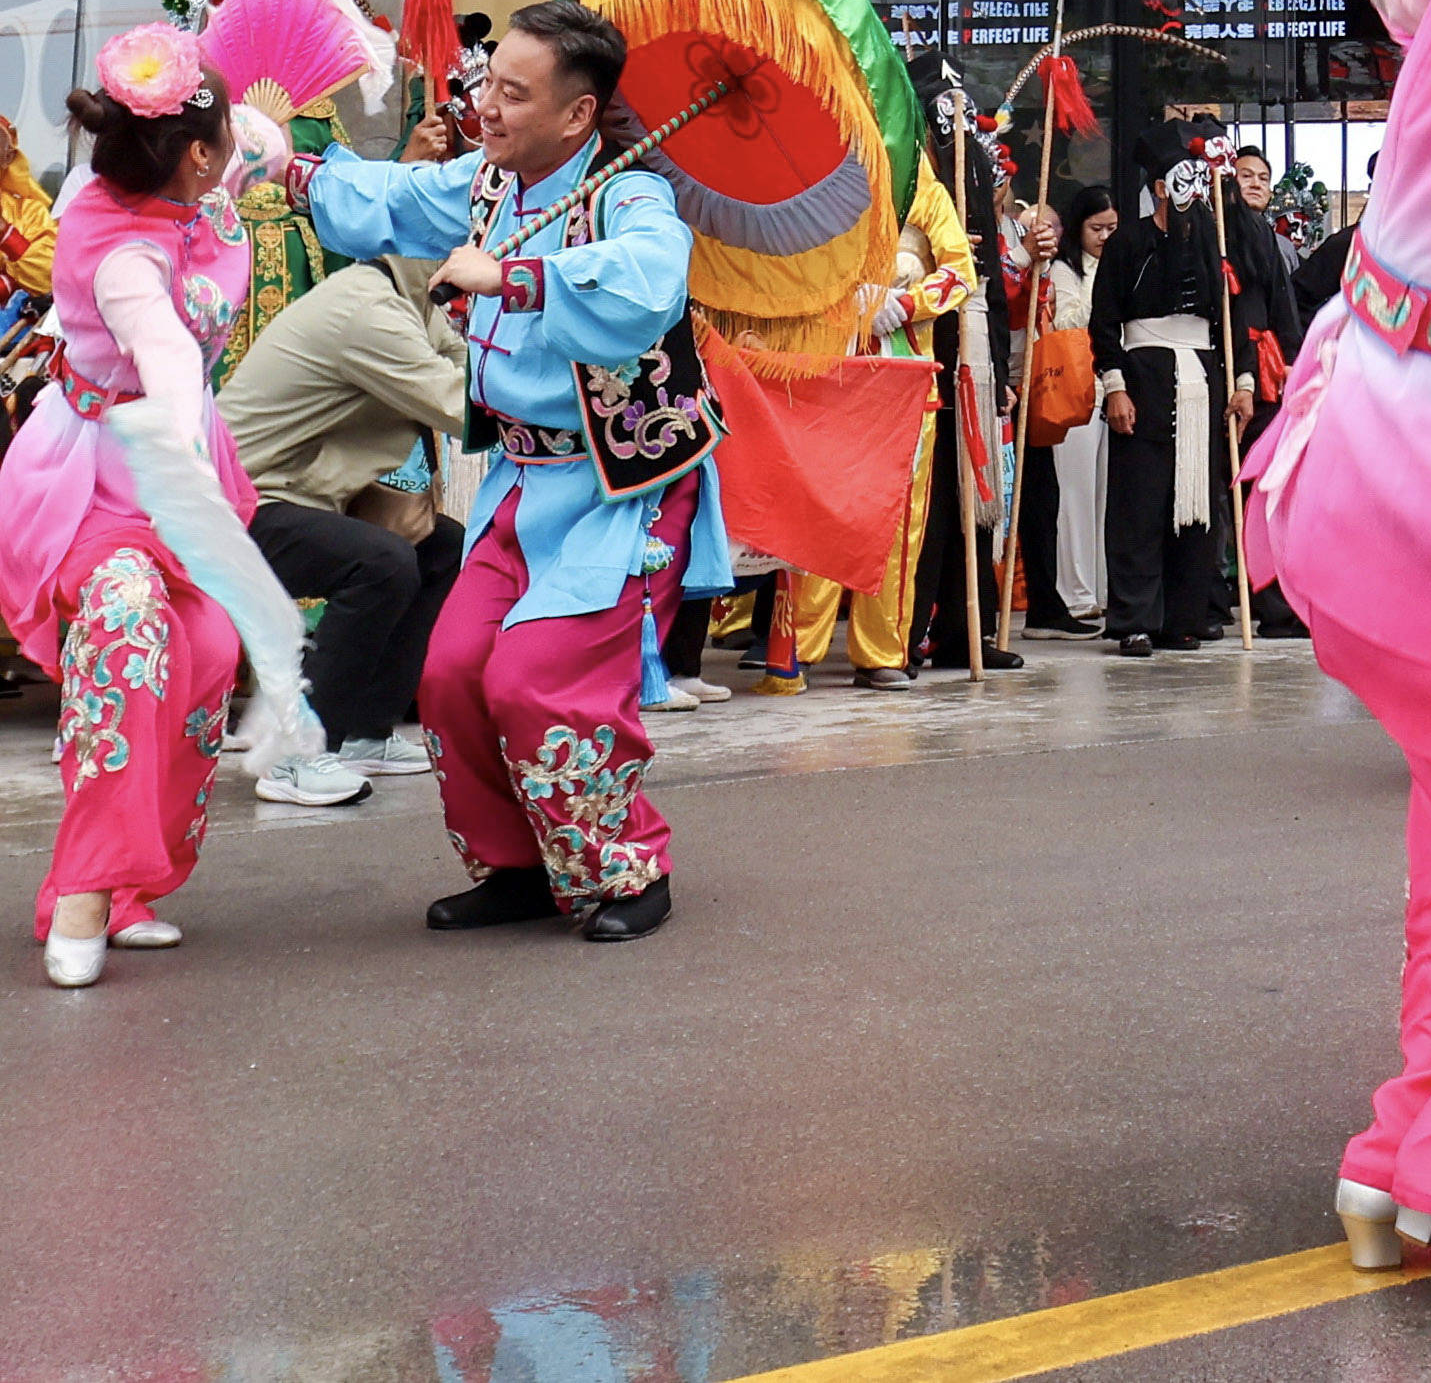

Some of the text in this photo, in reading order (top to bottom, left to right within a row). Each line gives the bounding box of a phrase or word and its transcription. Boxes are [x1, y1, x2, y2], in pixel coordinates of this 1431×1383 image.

[962, 26, 1049, 45] PERFECT LIFE
[1184, 23, 1255, 40] 完美人生
[1263, 21, 1346, 39] ERFECT LIFE
